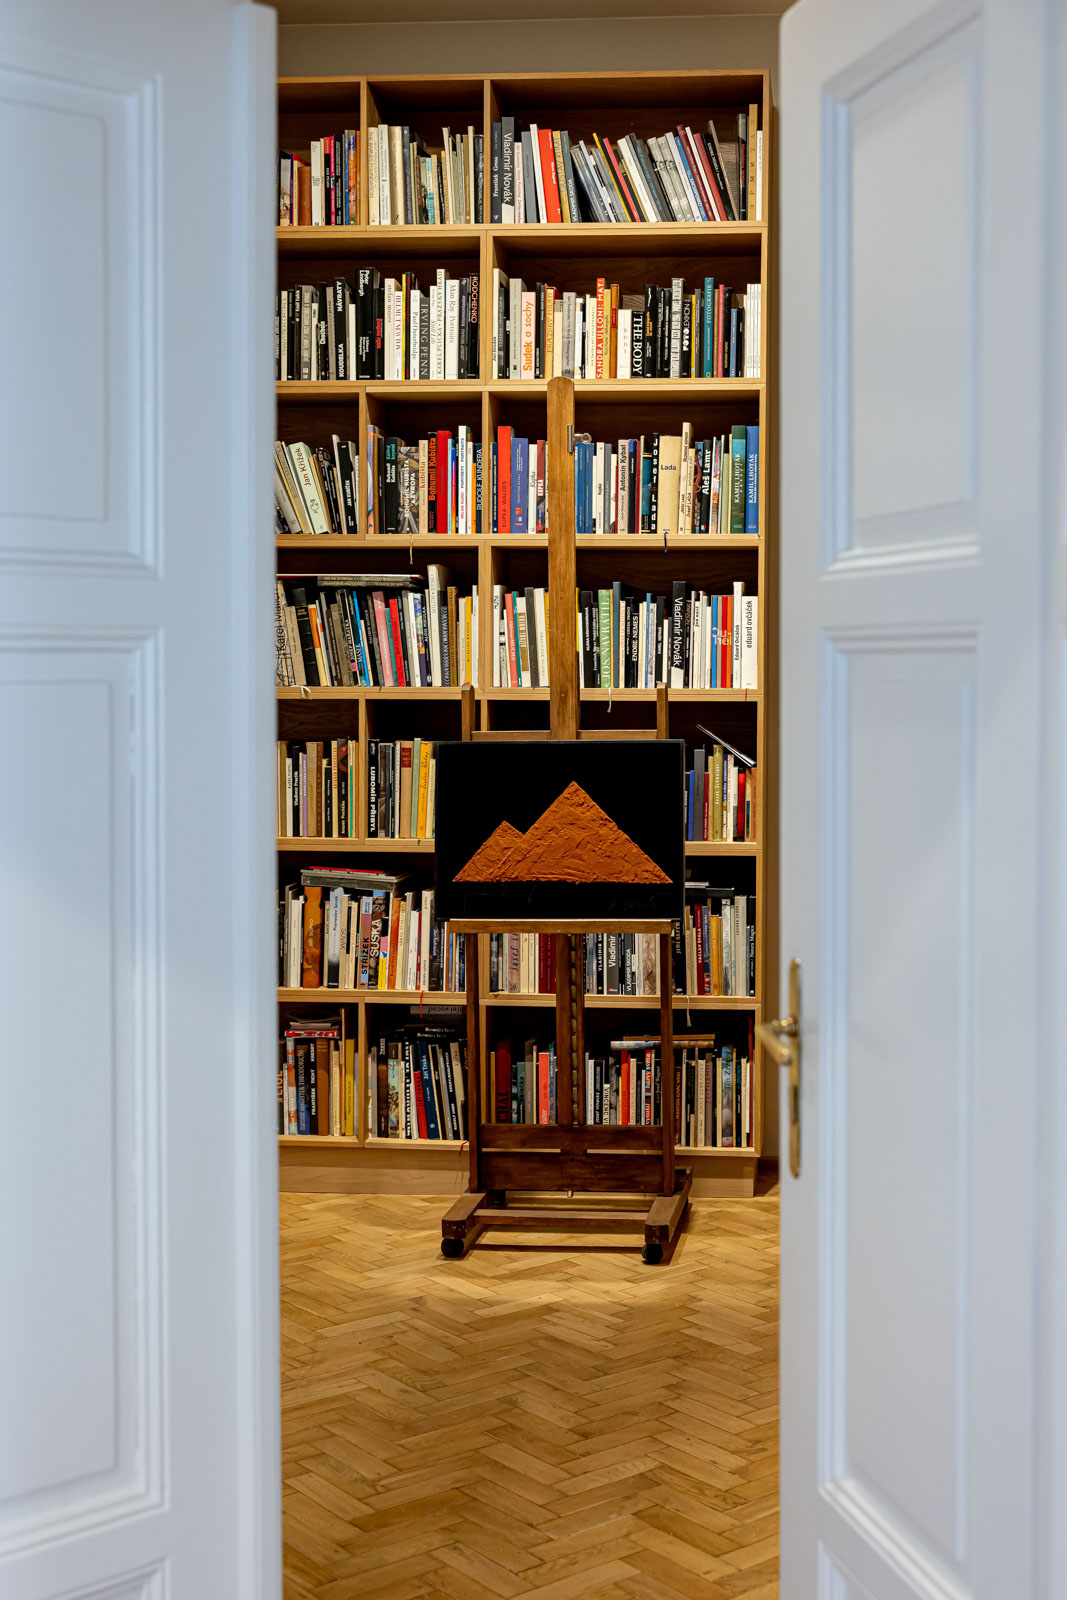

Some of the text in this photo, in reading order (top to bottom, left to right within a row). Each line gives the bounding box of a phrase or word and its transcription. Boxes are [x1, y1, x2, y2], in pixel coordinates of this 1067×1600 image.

[504, 133, 513, 202] Vladimír Novák
[523, 302, 533, 327] sochy
[420, 303, 428, 376] IRVING PENN
[523, 342, 532, 371] Sudek
[632, 315, 643, 374] THE BODY
[293, 447, 312, 487] Jan Křížek
[702, 449, 711, 494] Aleš Lamr
[275, 626, 285, 651] Karel
[600, 598, 610, 679] JOS. NAVRÁTIL
[673, 597, 683, 666] Vladimír Novák
[360, 937, 369, 975] STŘÍŽEK
[370, 918, 381, 958] SUSKA
